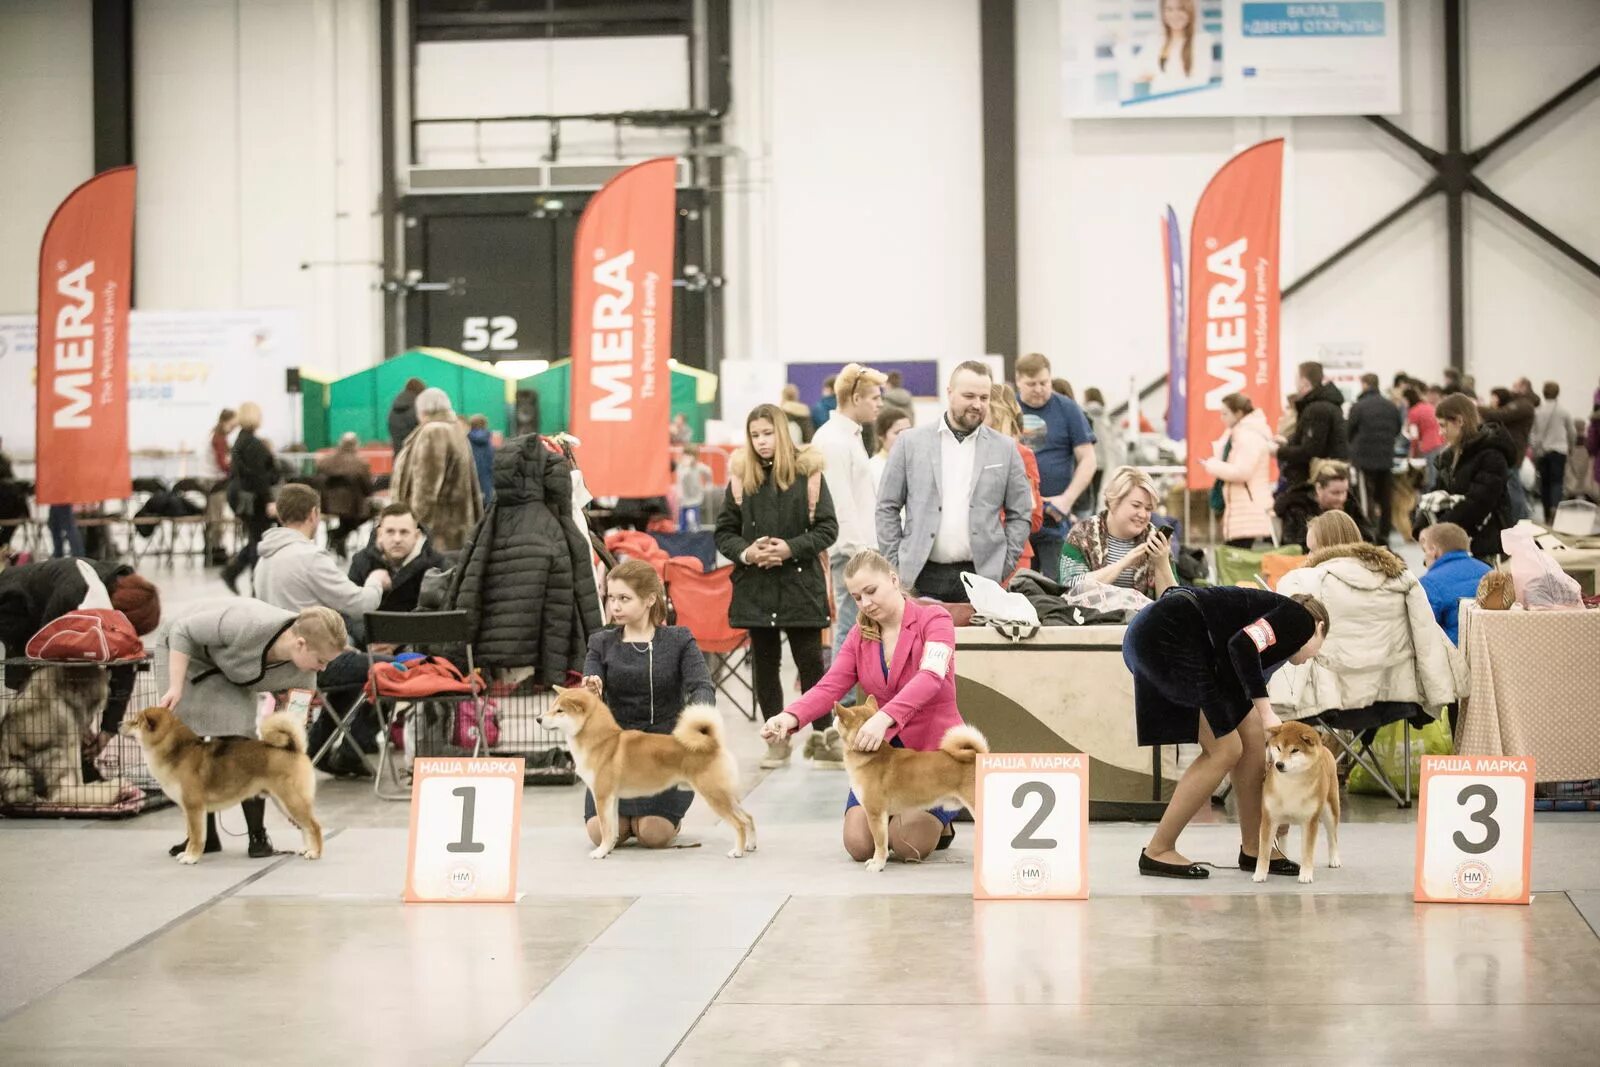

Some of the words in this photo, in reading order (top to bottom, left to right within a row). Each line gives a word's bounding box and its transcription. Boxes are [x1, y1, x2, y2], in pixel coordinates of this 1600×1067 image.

[53, 260, 95, 428] MERA
[461, 315, 519, 351] 52
[590, 249, 635, 422] MERA
[420, 761, 463, 774] НАША
[467, 761, 518, 774] МАРКА
[982, 757, 1027, 769] НАША
[1030, 757, 1082, 769] МАРКА
[1427, 759, 1472, 772] НАША
[1476, 760, 1528, 773] МАРКА
[446, 786, 485, 853] 1
[1011, 781, 1057, 849] 2
[1453, 784, 1500, 854] 3
[1464, 872, 1482, 881] НМ
